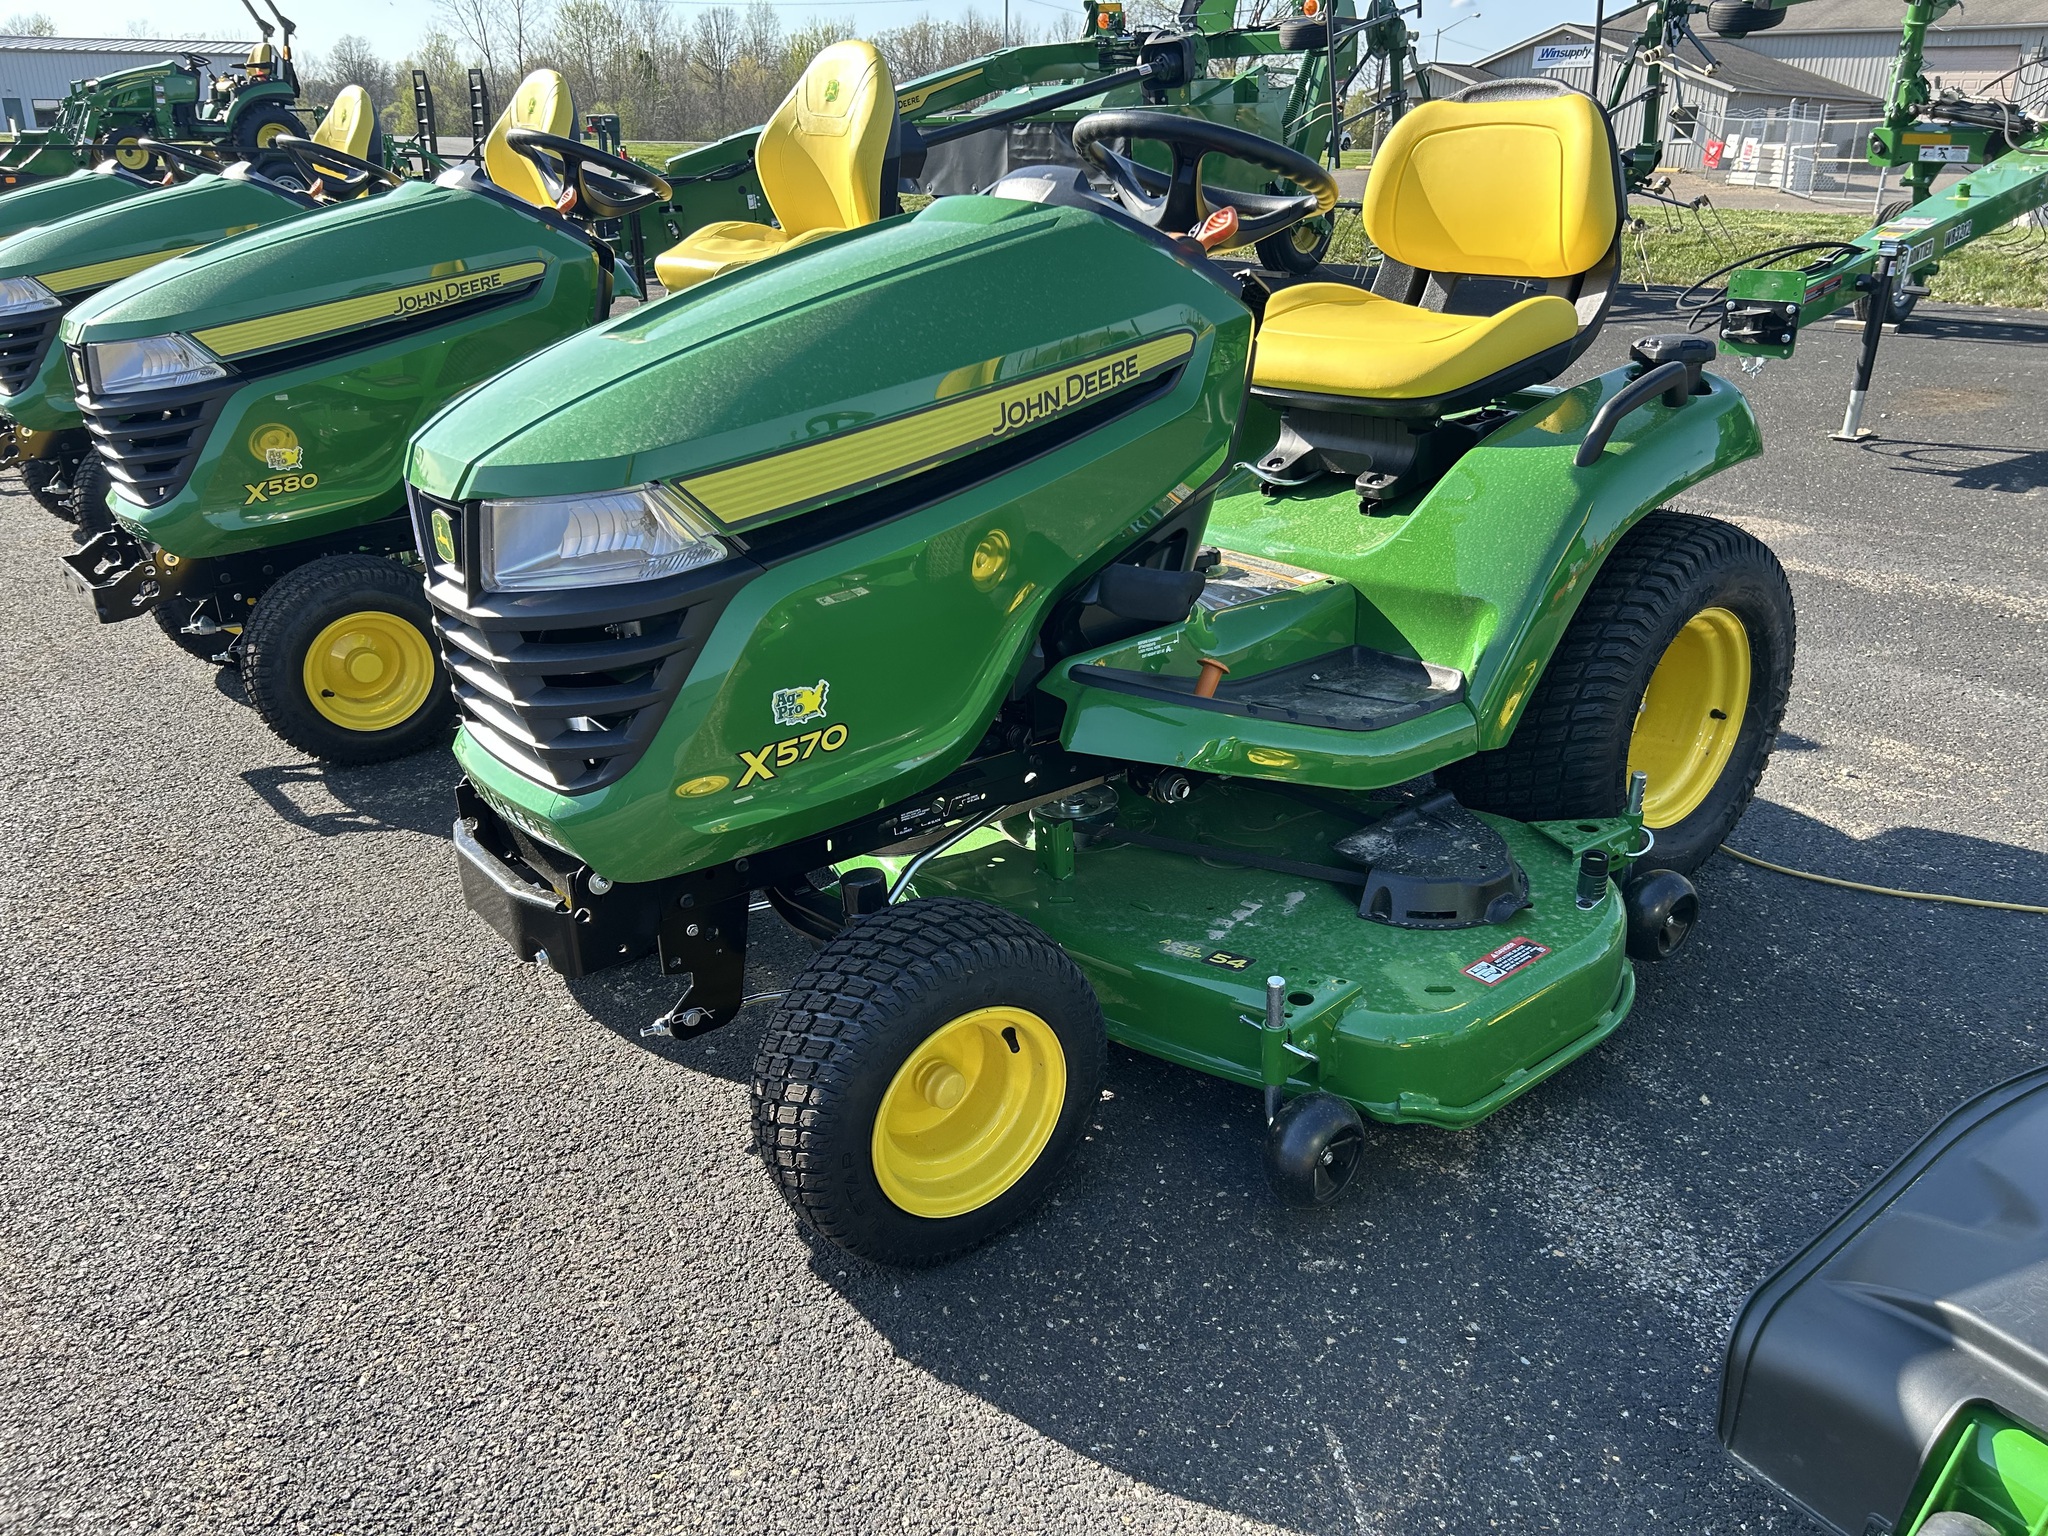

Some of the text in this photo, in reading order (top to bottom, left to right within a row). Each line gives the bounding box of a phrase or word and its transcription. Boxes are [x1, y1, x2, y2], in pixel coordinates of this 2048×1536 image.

[1540, 46, 1592, 60] Winsupply
[897, 95, 920, 109] DEERE
[394, 273, 502, 314] JOHN DEERE
[992, 354, 1139, 433] JOHN DEERE
[243, 472, 319, 505] X580
[777, 703, 804, 720] Pro
[733, 723, 848, 790] X570
[1208, 953, 1248, 969] 54
